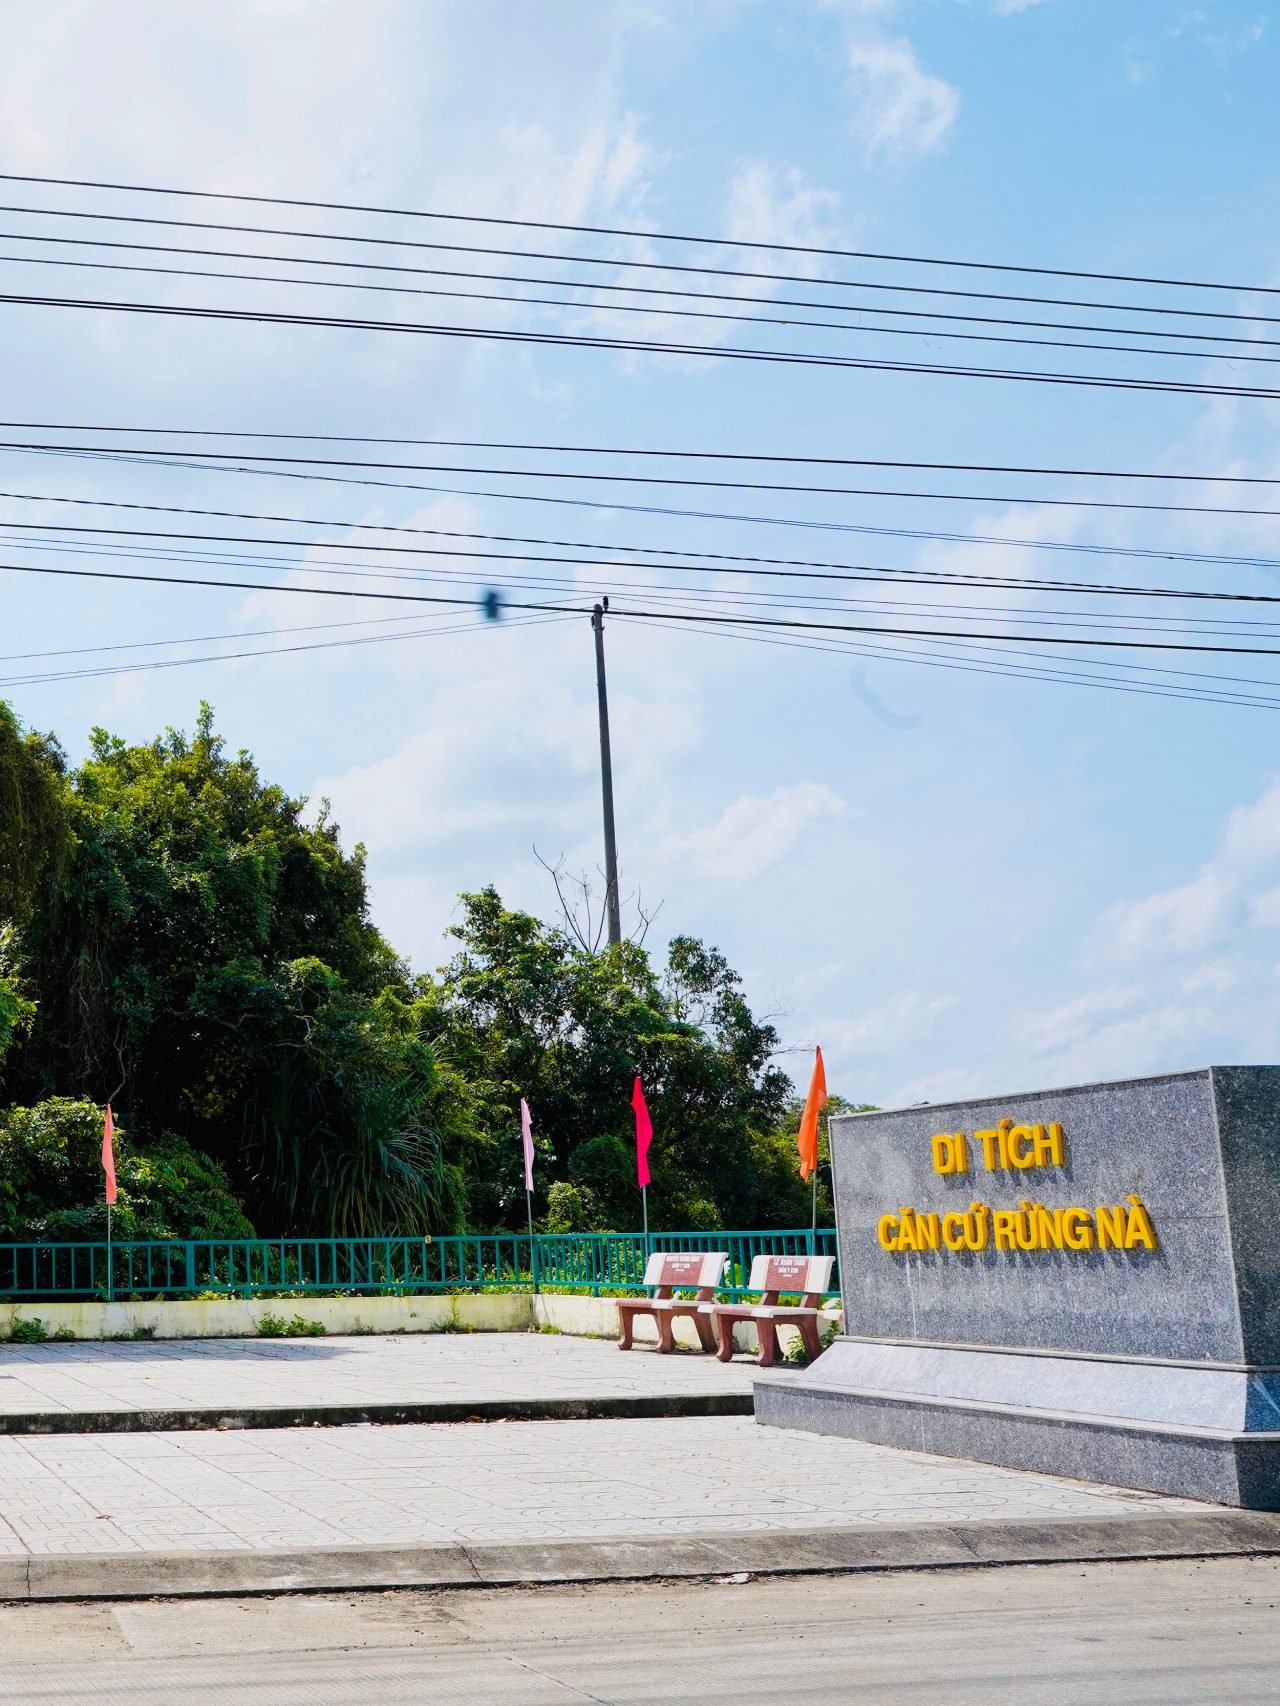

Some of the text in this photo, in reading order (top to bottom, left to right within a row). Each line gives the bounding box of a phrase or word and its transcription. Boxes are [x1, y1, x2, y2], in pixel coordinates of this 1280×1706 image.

[931, 1118, 1065, 1175] DI TÍCH
[877, 1196, 1159, 1251] CĂN CỨ RỪNG NÀ
